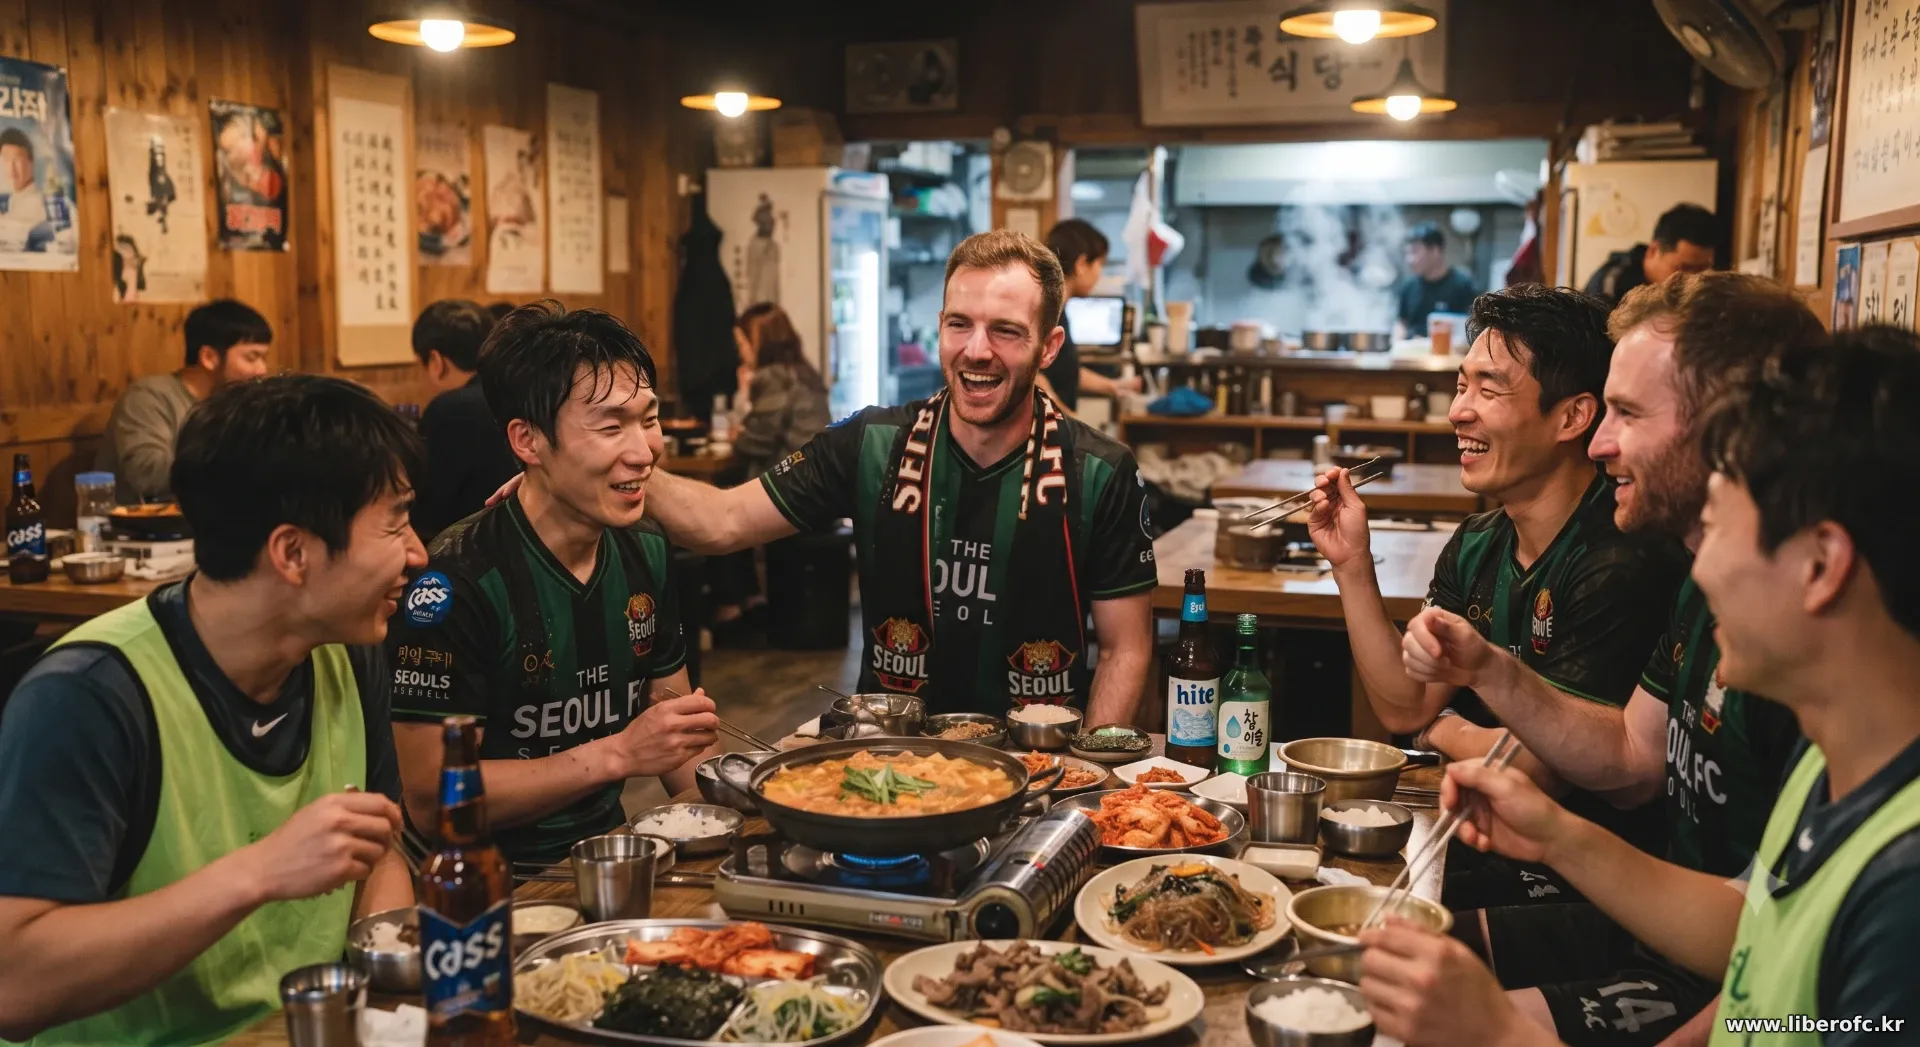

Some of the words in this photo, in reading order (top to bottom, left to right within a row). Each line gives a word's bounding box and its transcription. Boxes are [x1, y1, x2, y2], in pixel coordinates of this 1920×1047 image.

[950, 539, 992, 560] THE
[872, 644, 929, 679] SEOUL
[394, 668, 451, 690] SEOULS
[576, 664, 609, 688] THE
[1008, 650, 1075, 697] SEOUL
[1176, 683, 1215, 706] hite
[509, 688, 620, 739] SEOUL
[1243, 708, 1259, 731] 참
[1243, 727, 1264, 747] 이슬
[1694, 751, 1727, 805] FC
